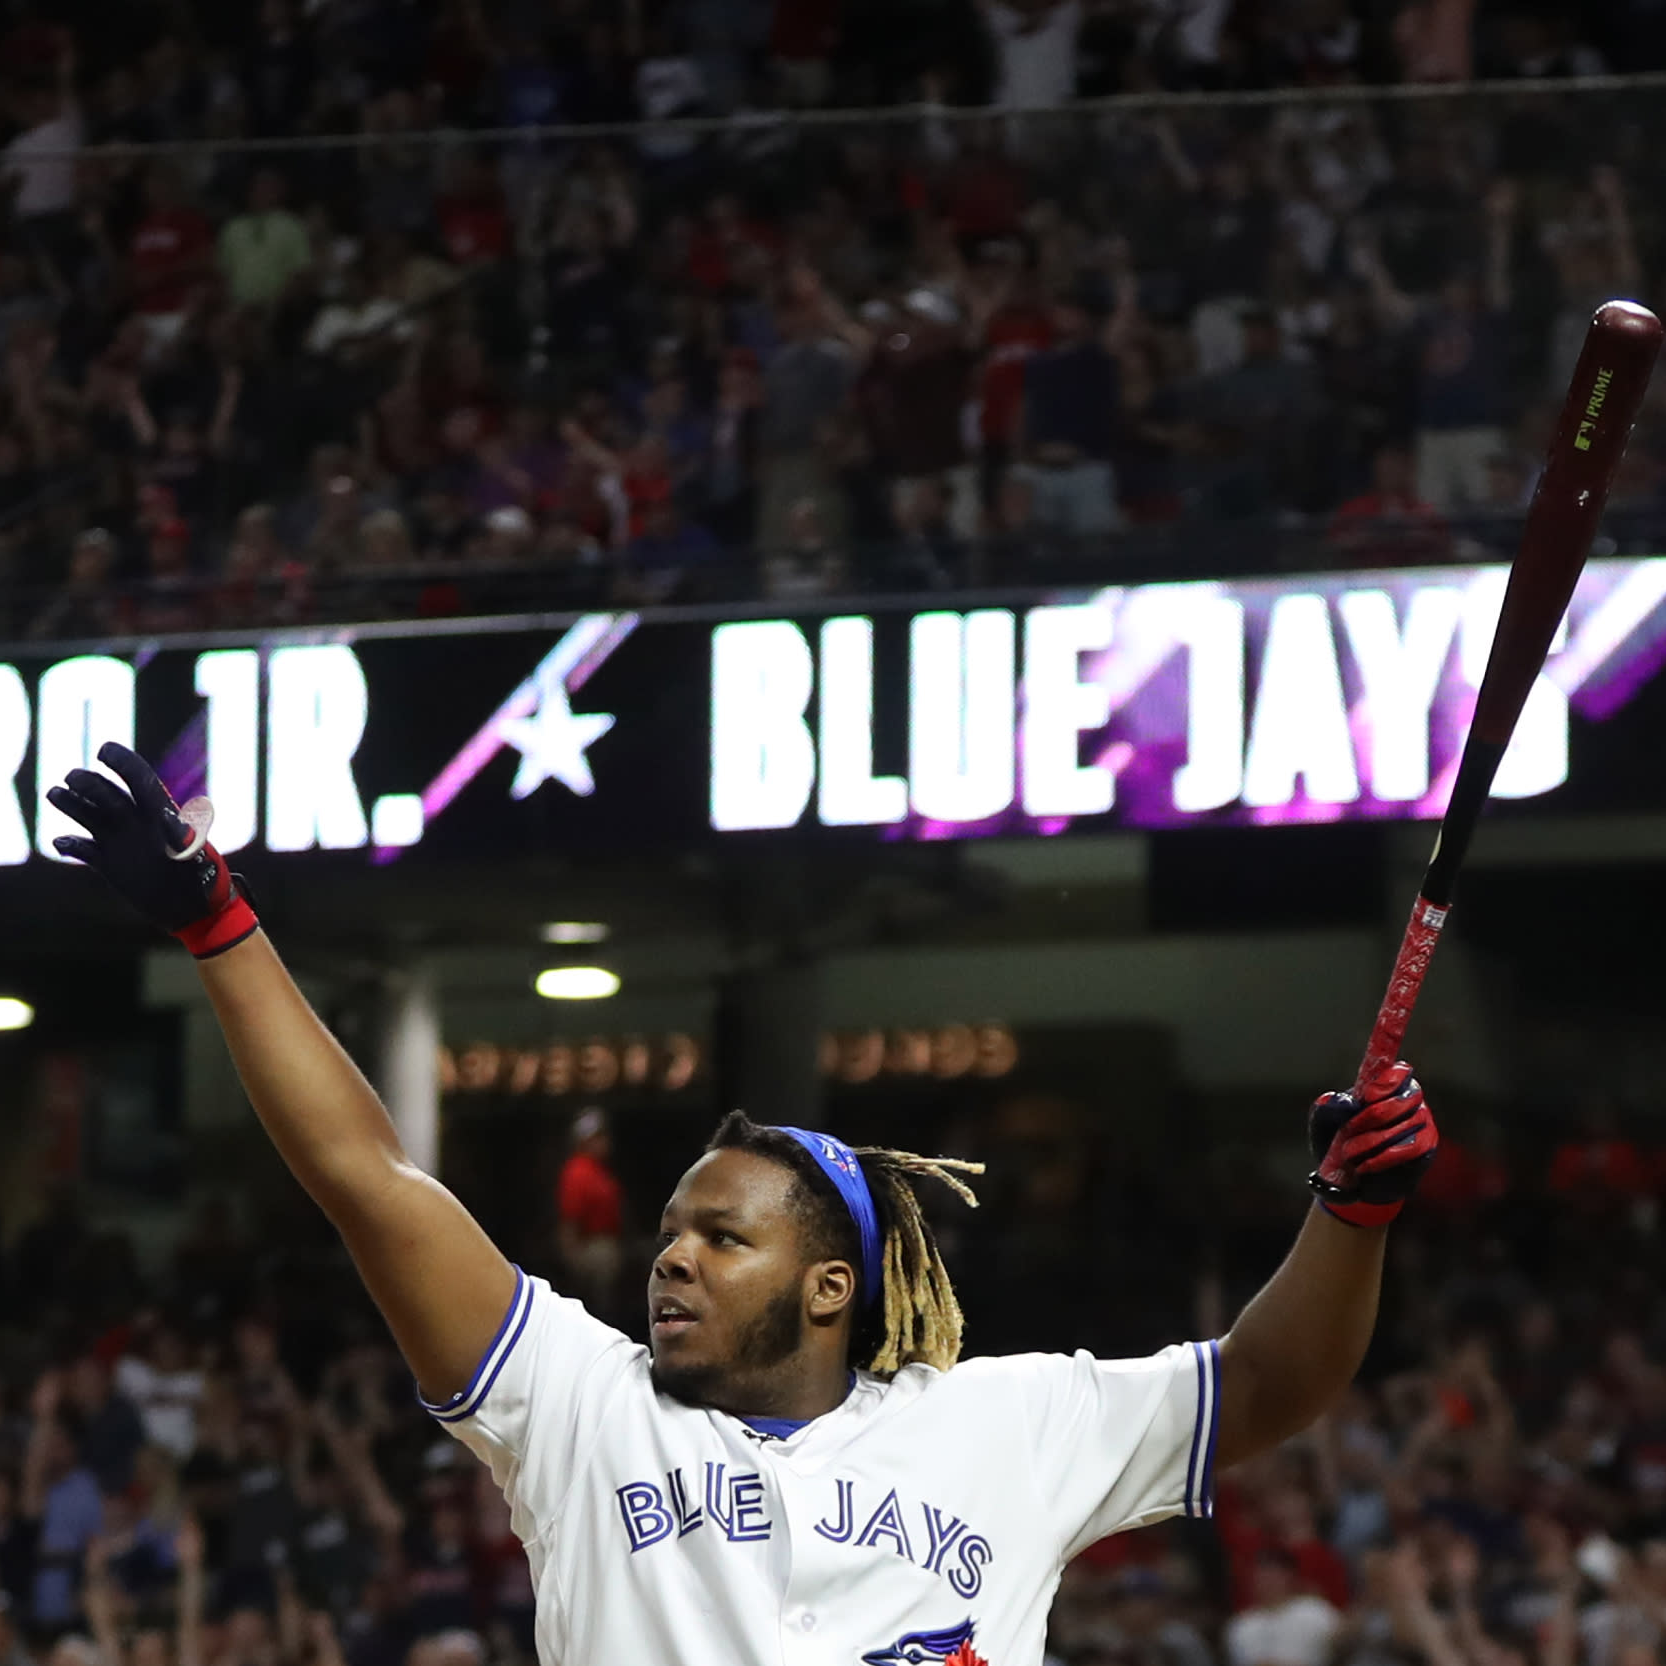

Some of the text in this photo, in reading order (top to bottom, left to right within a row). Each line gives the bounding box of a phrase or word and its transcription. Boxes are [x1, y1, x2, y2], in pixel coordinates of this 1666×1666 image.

[1586, 366, 1614, 418] PRIME
[194, 643, 425, 858] JR.
[710, 602, 1116, 832] BLUE
[615, 1461, 993, 1600] BLUE JAYS
